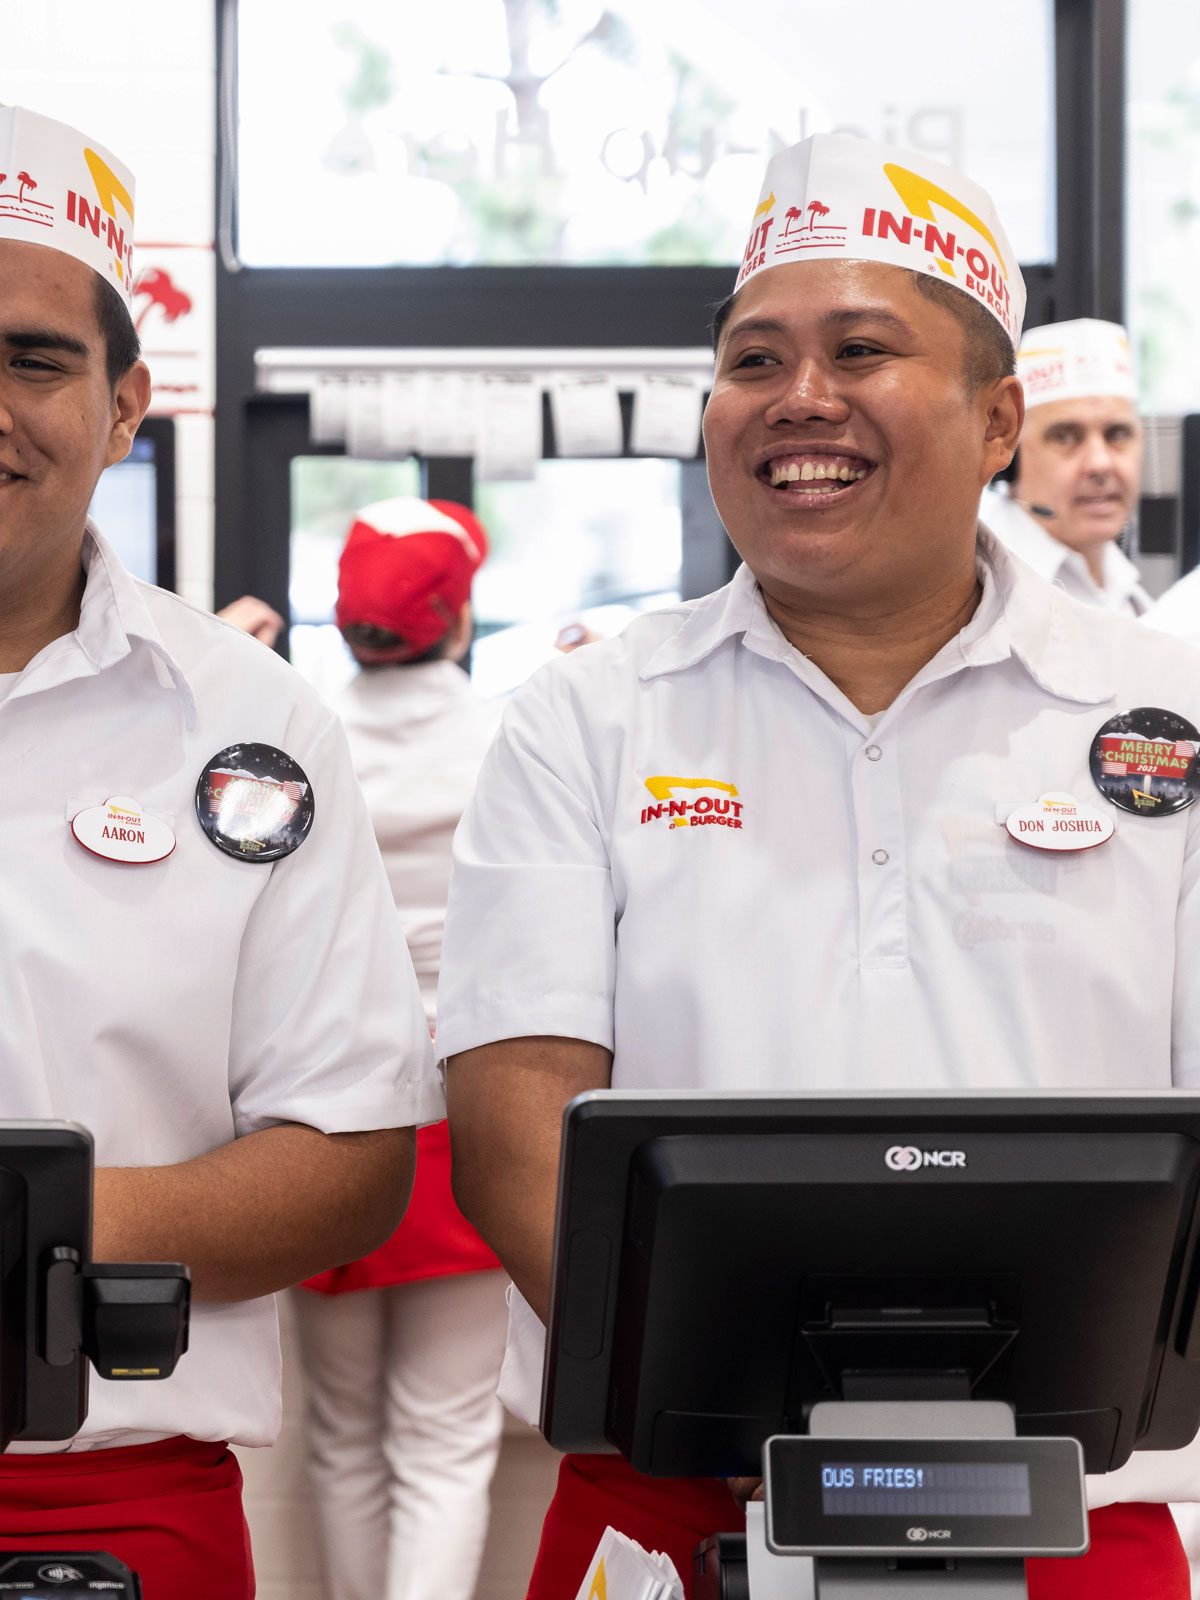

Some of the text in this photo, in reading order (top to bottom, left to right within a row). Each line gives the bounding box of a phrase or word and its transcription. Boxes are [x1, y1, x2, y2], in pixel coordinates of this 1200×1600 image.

[862, 207, 1011, 316] IN-N-OUT
[965, 274, 1011, 332] BURGER
[1120, 740, 1174, 756] MERRY
[1105, 750, 1189, 769] CHRISTMAS
[1136, 764, 1158, 773] 2023
[107, 813, 142, 823] IN-N-OUT
[641, 796, 743, 824] IN-N-OUT
[690, 814, 743, 829] BURGER
[1019, 820, 1102, 832] DON JOSHUA
[101, 825, 145, 844] AARON
[923, 1150, 967, 1167] NCR
[822, 1467, 924, 1488] OUS FRIES!
[928, 1530, 952, 1539] NCR
